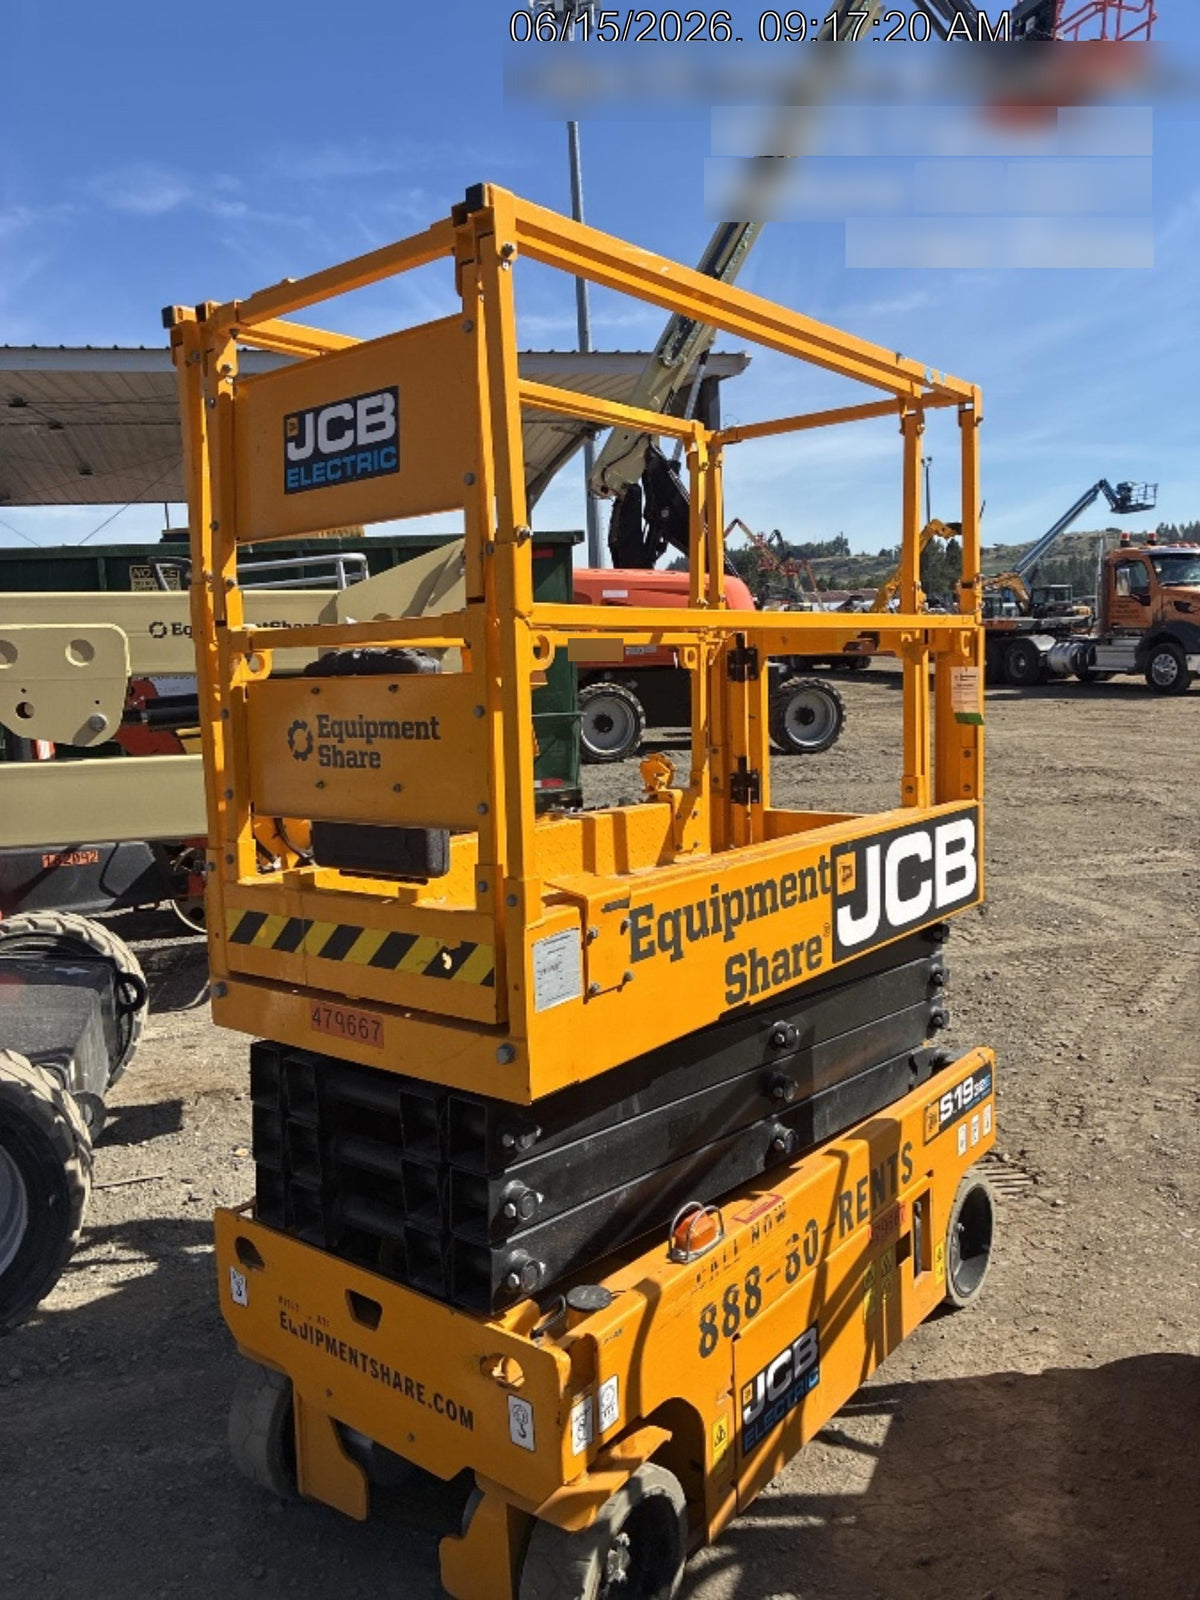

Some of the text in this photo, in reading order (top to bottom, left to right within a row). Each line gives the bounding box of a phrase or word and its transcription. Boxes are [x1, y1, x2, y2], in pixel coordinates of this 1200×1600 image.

[287, 392, 396, 461] JCB
[287, 445, 397, 490] ELECTRIC
[316, 714, 441, 744] Equipment
[318, 744, 381, 769] Share
[629, 854, 832, 963] Equipment
[837, 818, 977, 947] JCB
[312, 1007, 380, 1041] 479667
[743, 1327, 818, 1425] JCB
